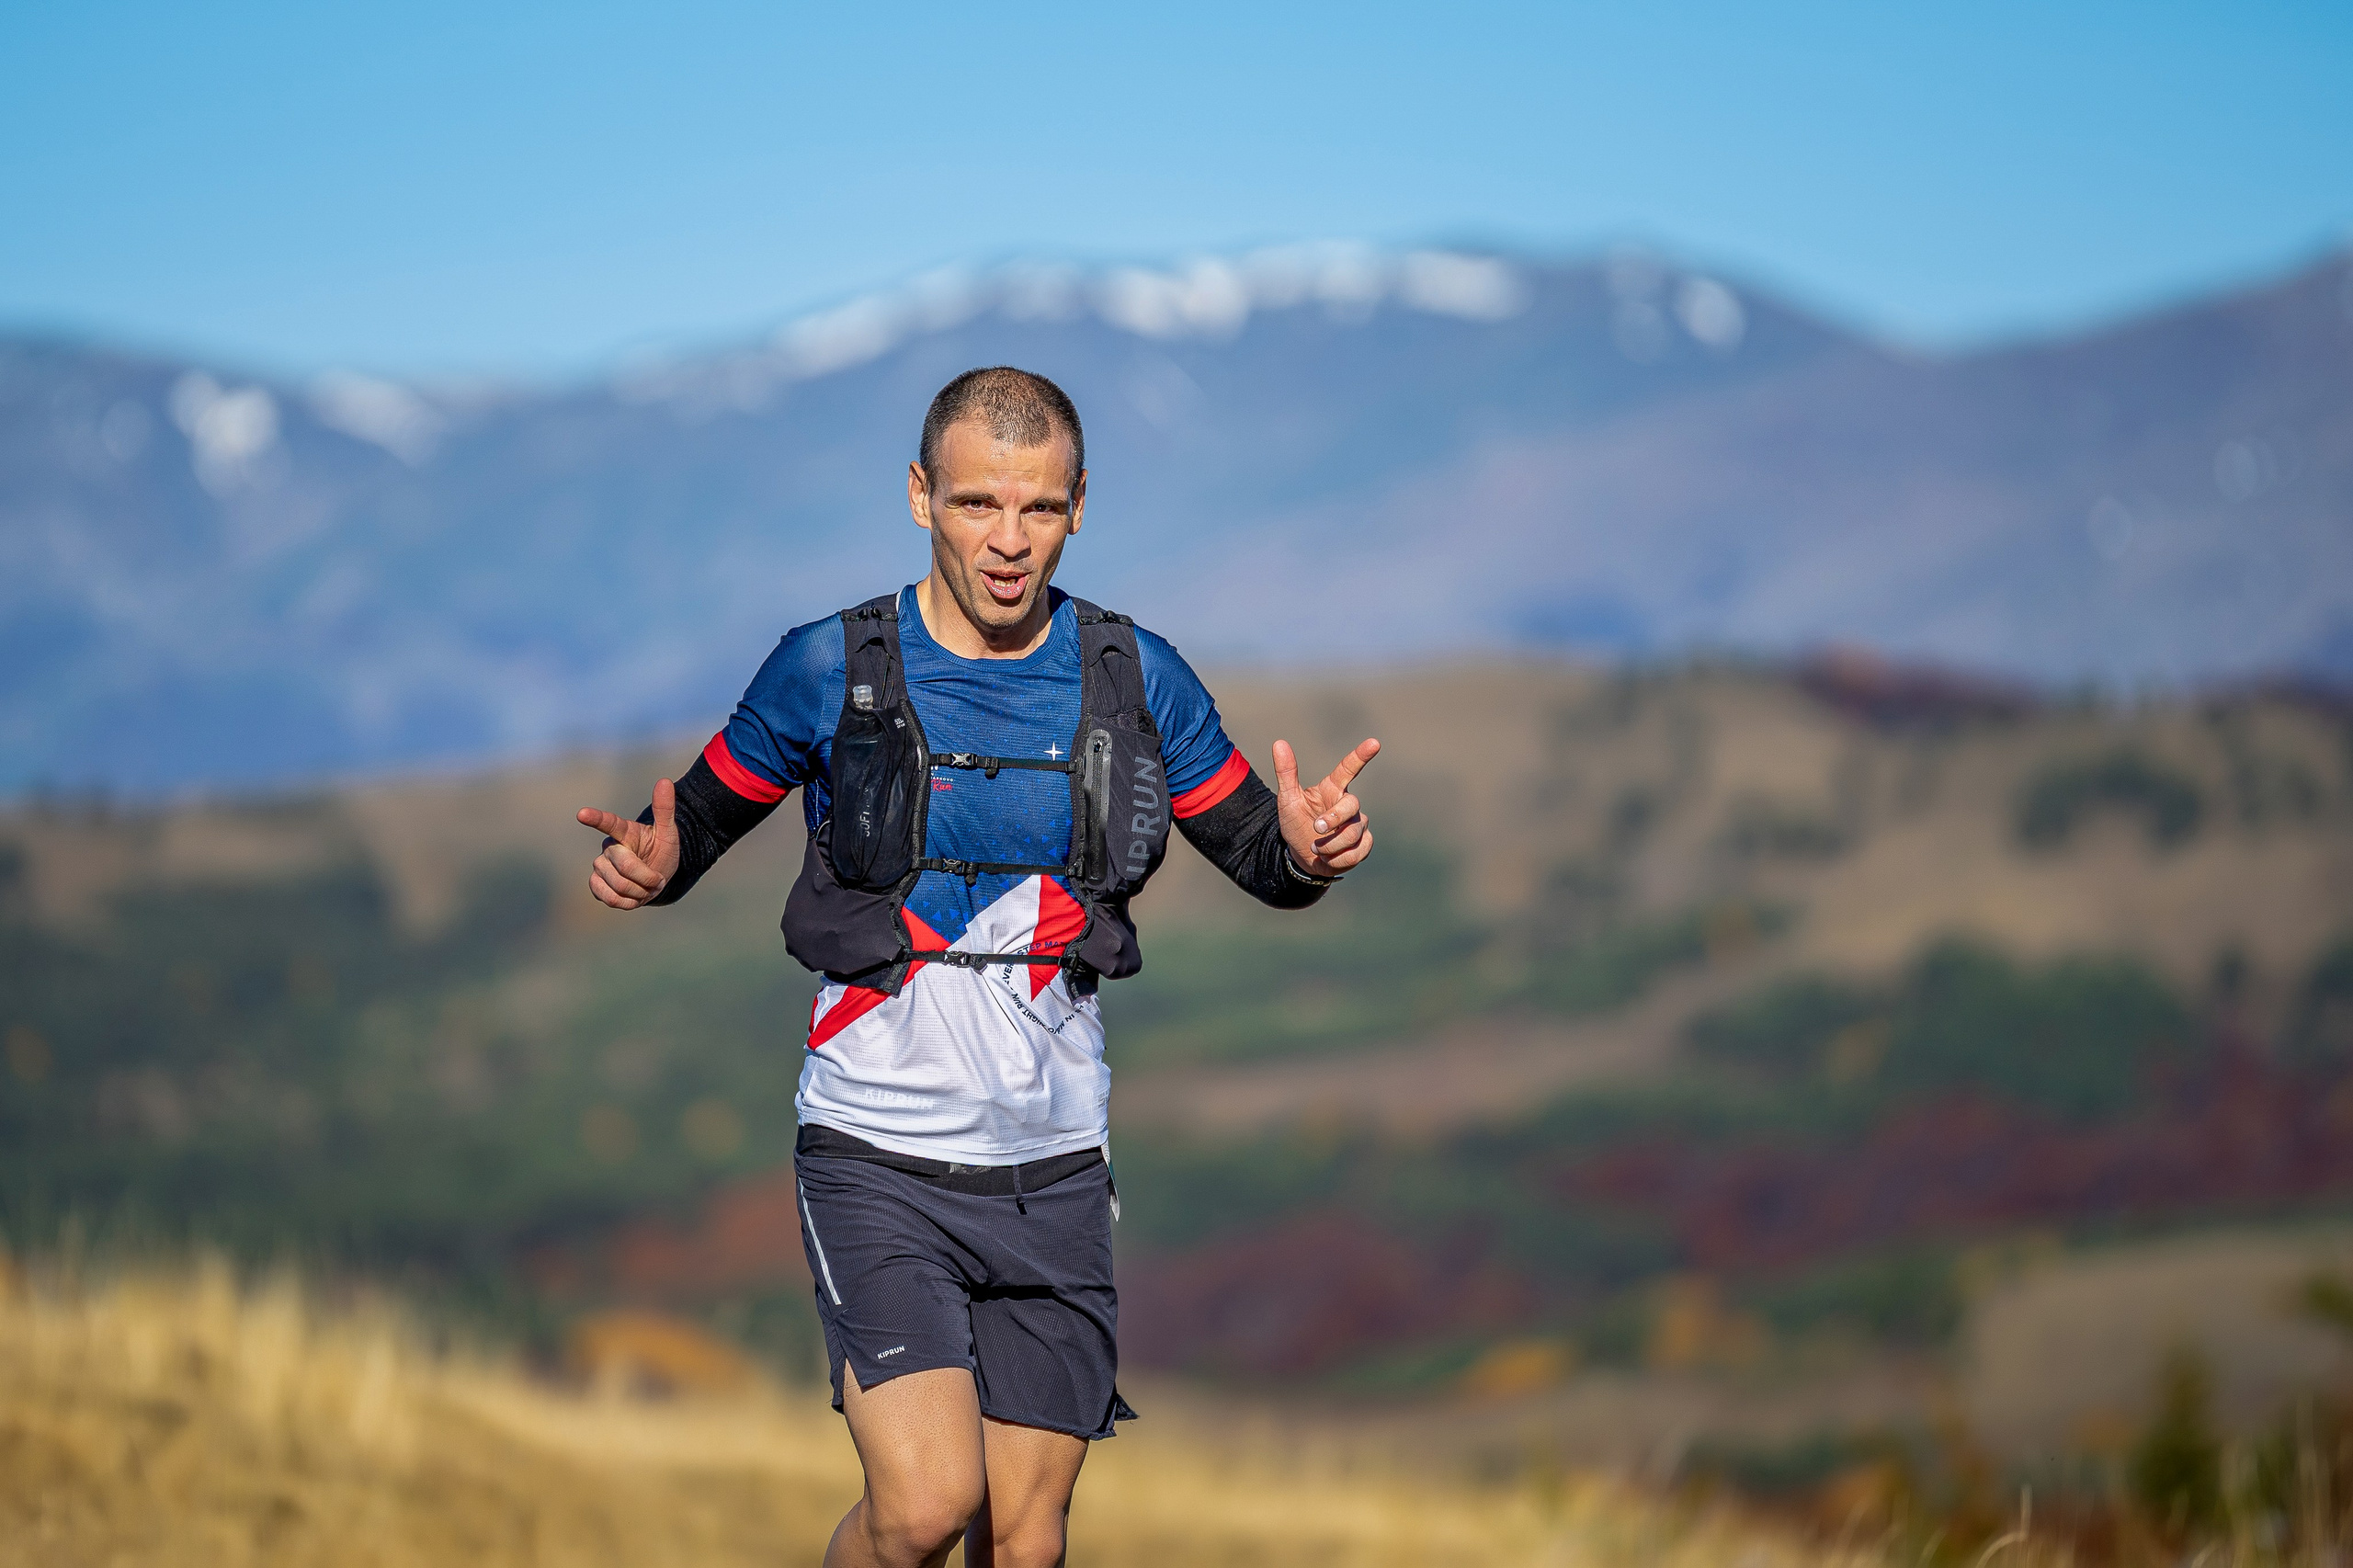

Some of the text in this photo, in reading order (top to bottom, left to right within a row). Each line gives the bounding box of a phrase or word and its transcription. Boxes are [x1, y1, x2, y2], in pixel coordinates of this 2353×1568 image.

[930, 779, 953, 791] Run
[1126, 756, 1160, 873] IPRUN
[1017, 943, 1041, 956] STEP
[877, 1346, 905, 1359] KIPRUN
